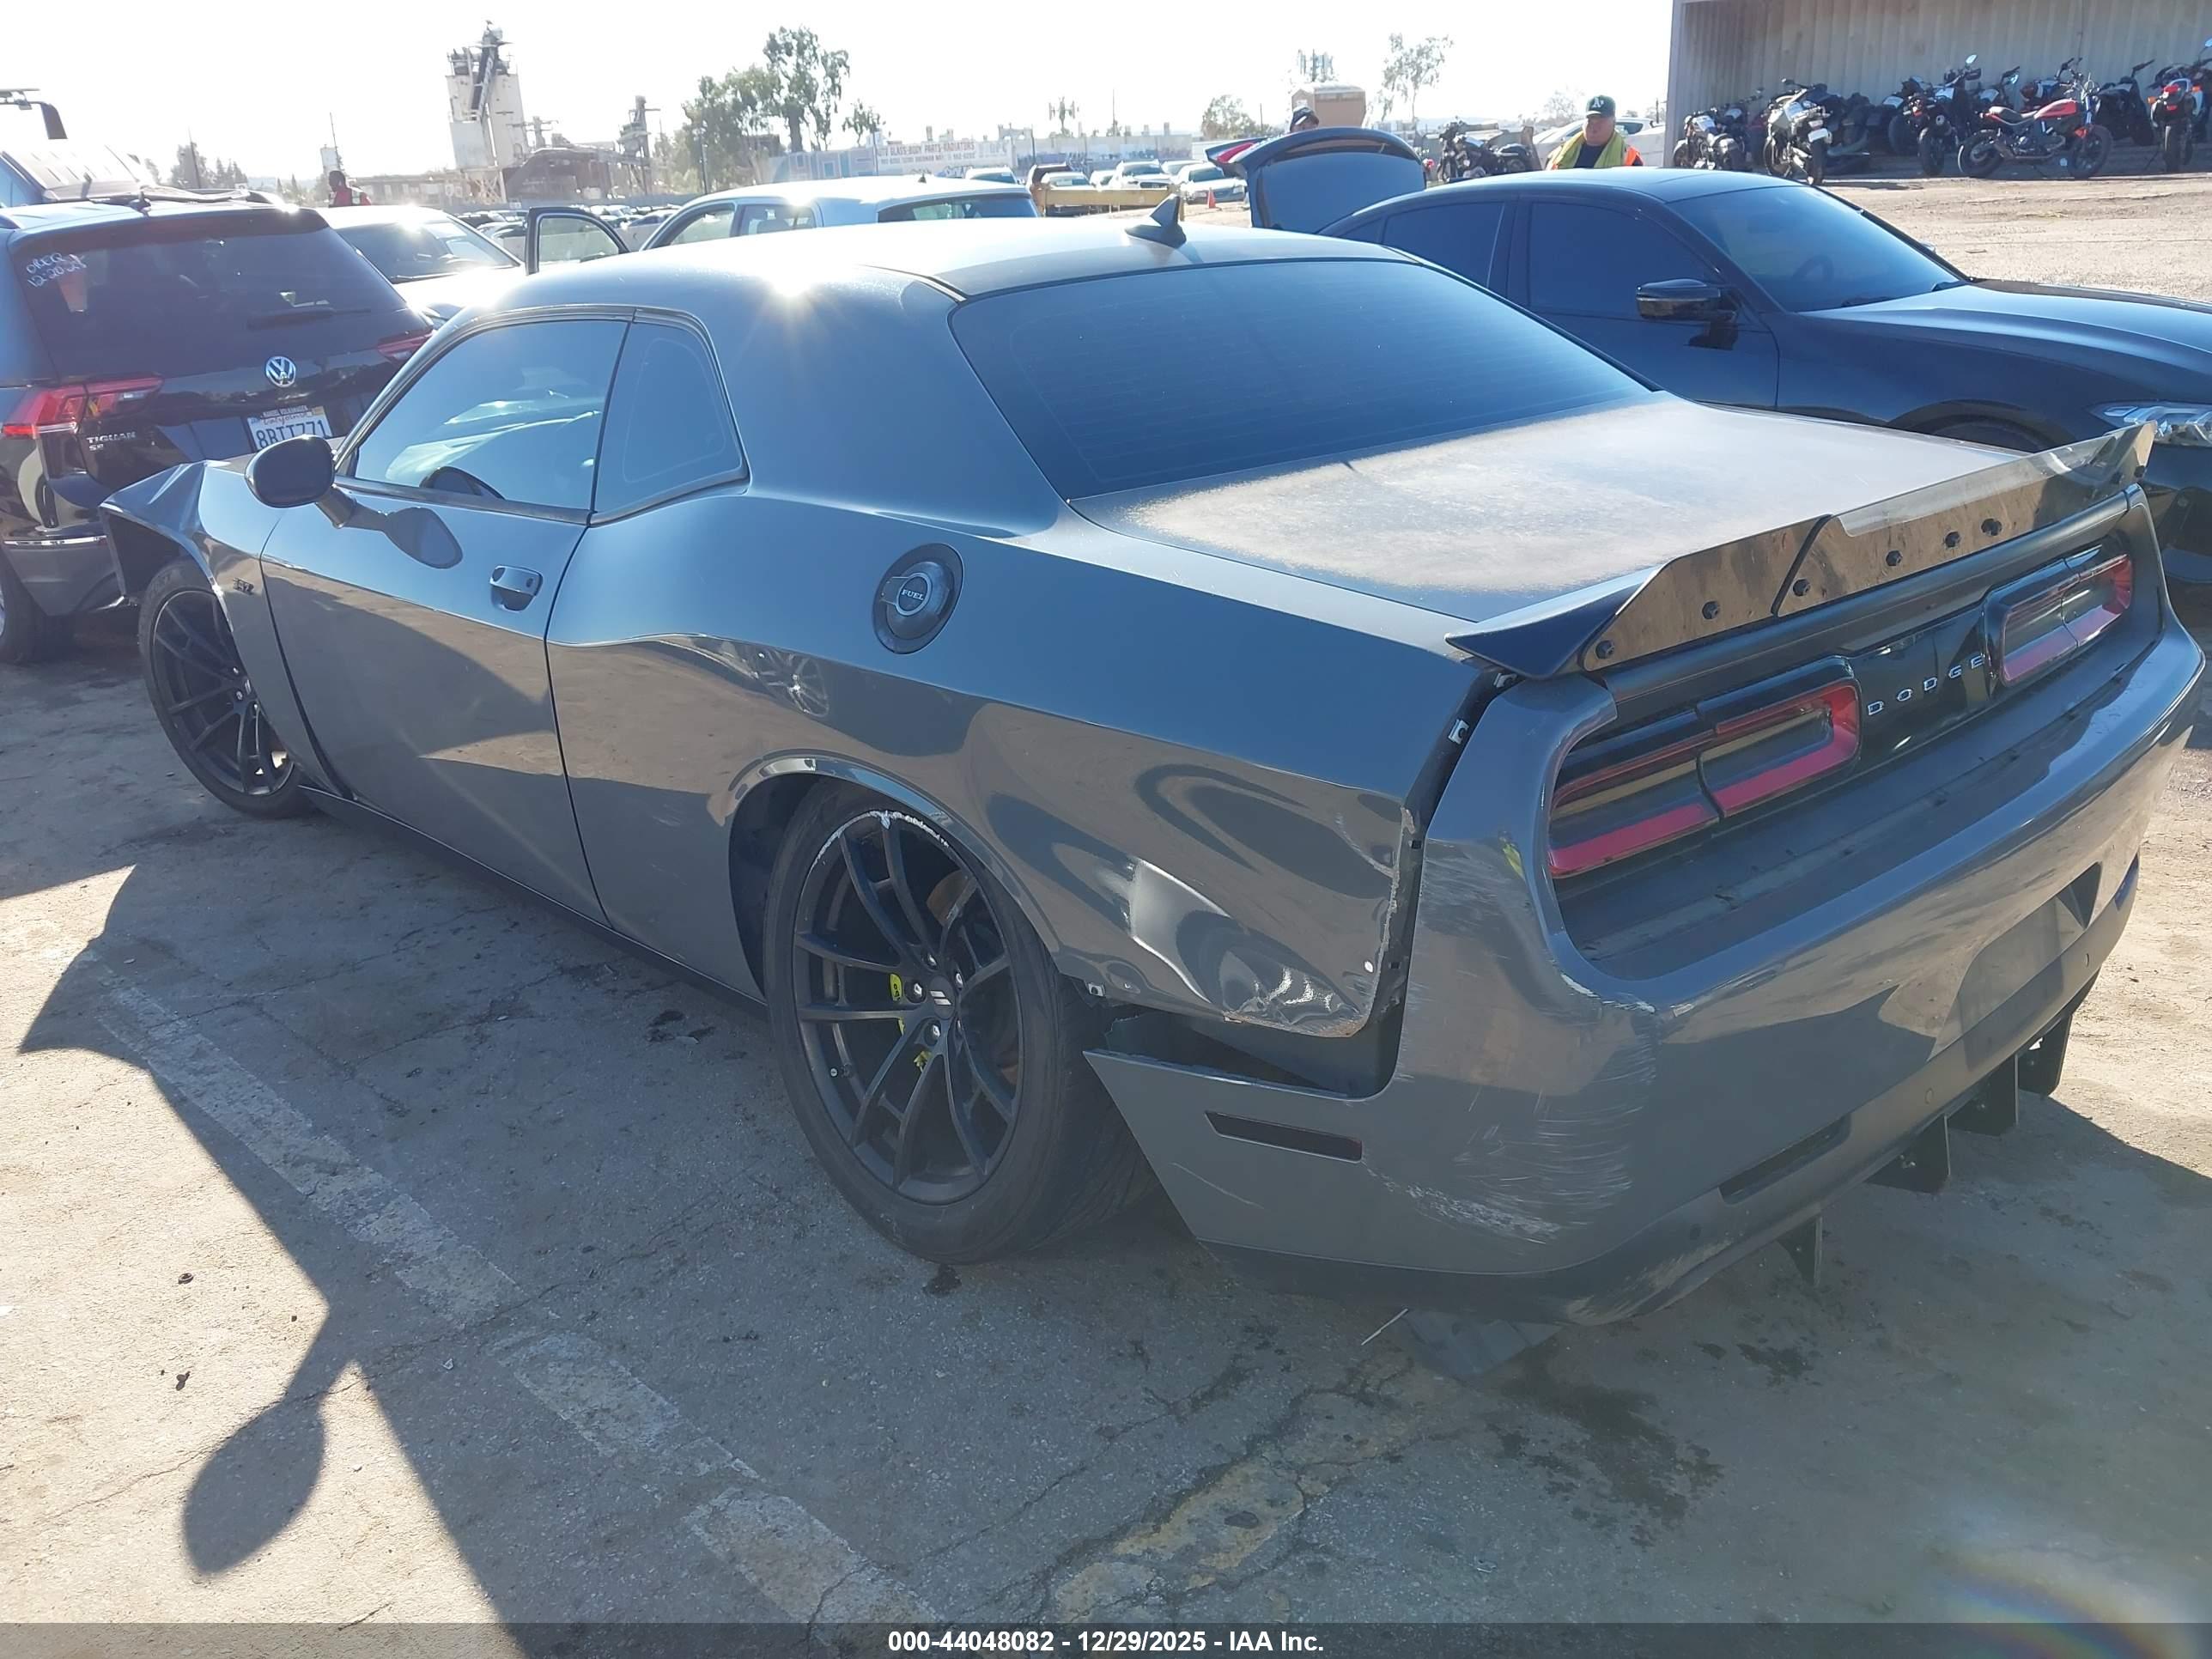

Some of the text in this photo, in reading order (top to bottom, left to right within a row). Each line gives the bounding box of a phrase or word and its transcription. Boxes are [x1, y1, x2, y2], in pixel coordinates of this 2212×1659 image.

[86, 431, 136, 444] TIGUAN
[902, 589, 924, 600] FUEL
[1867, 653, 1984, 715] DODGE
